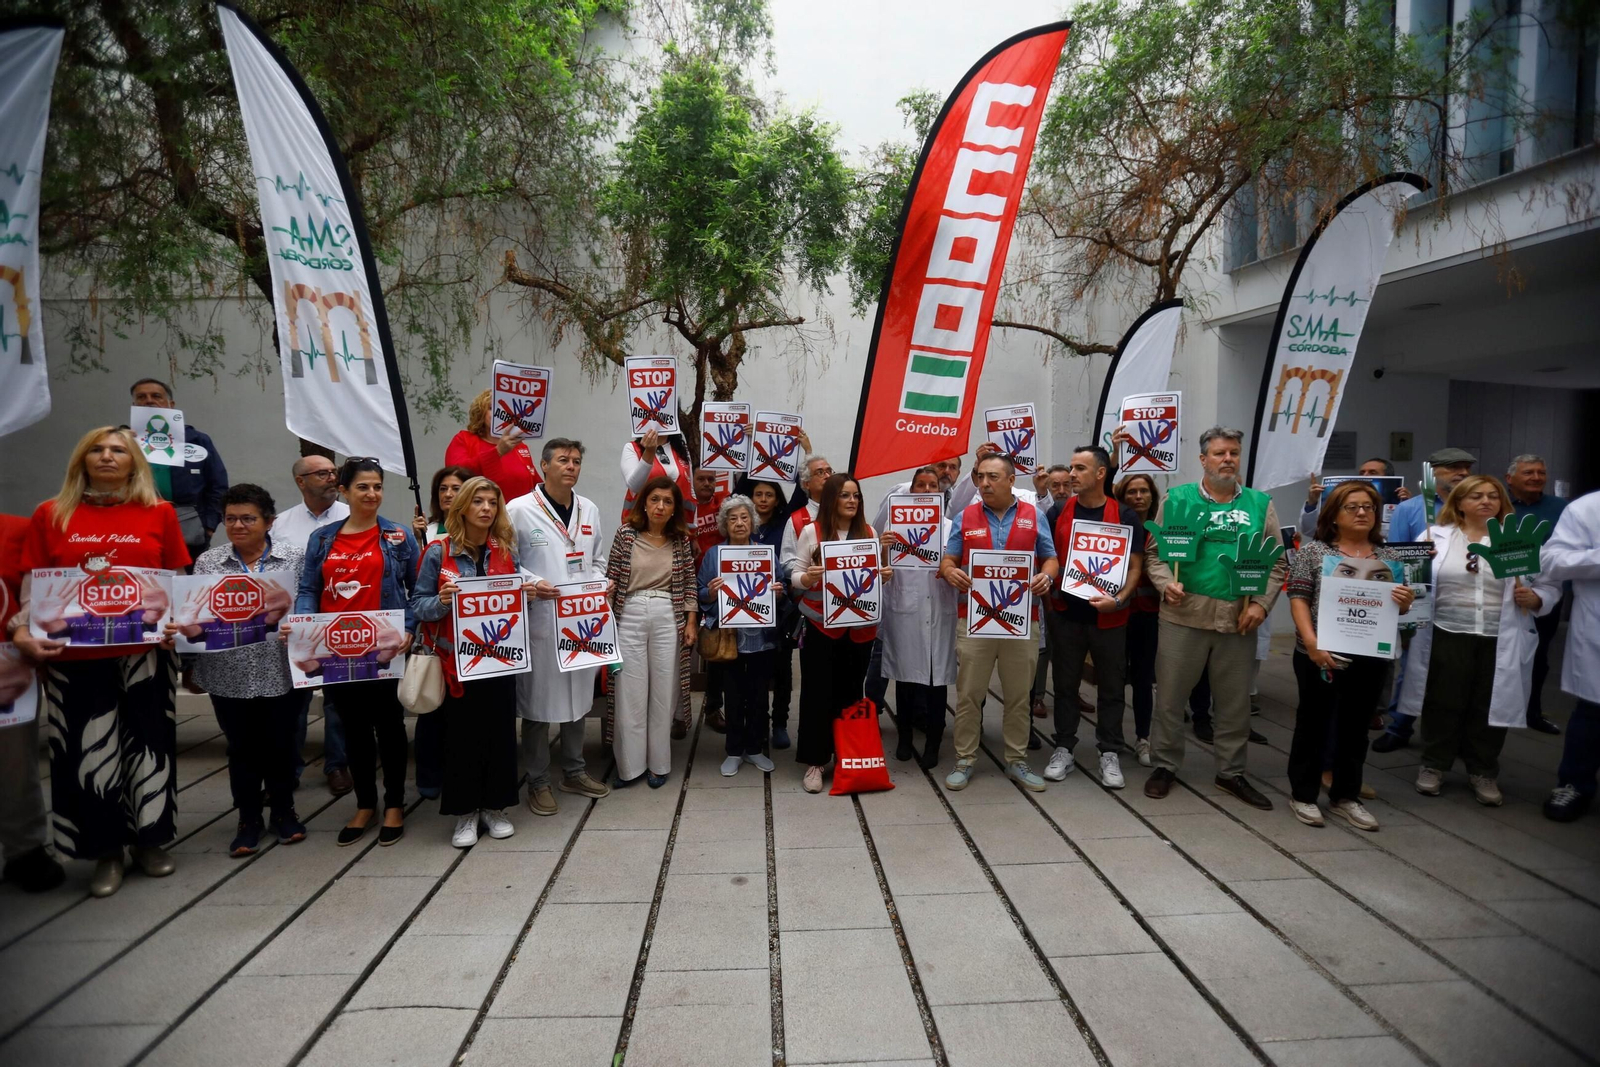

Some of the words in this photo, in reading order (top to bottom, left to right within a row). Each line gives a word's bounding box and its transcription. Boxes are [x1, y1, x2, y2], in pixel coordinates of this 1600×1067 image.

[911, 81, 1037, 352] CCOO
[1287, 313, 1355, 342] SMA
[1288, 339, 1348, 356] CÓRDOBA
[499, 376, 541, 395] STOP
[632, 370, 672, 386] STOP
[512, 398, 535, 418] NO
[647, 390, 668, 413] NO
[713, 412, 740, 423] STOP
[1133, 408, 1166, 419] STOP
[765, 423, 792, 434] STOP
[895, 418, 958, 437] Córdoba
[997, 418, 1024, 430] STOP
[718, 423, 745, 449] NO
[1002, 428, 1032, 454] NO
[1138, 419, 1173, 450] NO
[707, 443, 746, 462] AGSIONES
[768, 434, 795, 459] NO
[1126, 444, 1175, 462] AGSIONES
[756, 453, 795, 474] AGSIONES
[894, 508, 935, 522] STOP
[68, 533, 106, 543] Sanidad
[106, 533, 141, 543] Pública
[907, 527, 931, 547] NO
[1076, 536, 1121, 552] STOP
[731, 561, 762, 572] STOP
[836, 555, 867, 569] STOP
[1088, 556, 1113, 575] NO
[1505, 566, 1529, 574] SATSE
[98, 575, 126, 584] SAS
[984, 566, 1018, 578] STOP
[225, 581, 248, 592] SAS
[736, 572, 768, 602] NO
[842, 567, 875, 600] NO
[1066, 568, 1120, 595] AGRESIONES
[86, 584, 136, 601] STOP
[215, 591, 258, 607] STOP
[989, 579, 1024, 610] NO
[462, 593, 516, 615] STOP
[561, 595, 605, 615] STOP
[726, 596, 770, 615] AGSIONES
[831, 595, 877, 612] AGSIONES
[1348, 608, 1367, 618] NO
[339, 620, 363, 630] SAS
[481, 618, 511, 647] NO
[577, 617, 603, 642] NO
[331, 628, 371, 644] STOP
[458, 641, 524, 661] AGRESIONES
[558, 638, 614, 655] AGRESIONES
[841, 757, 880, 769] CCOO
